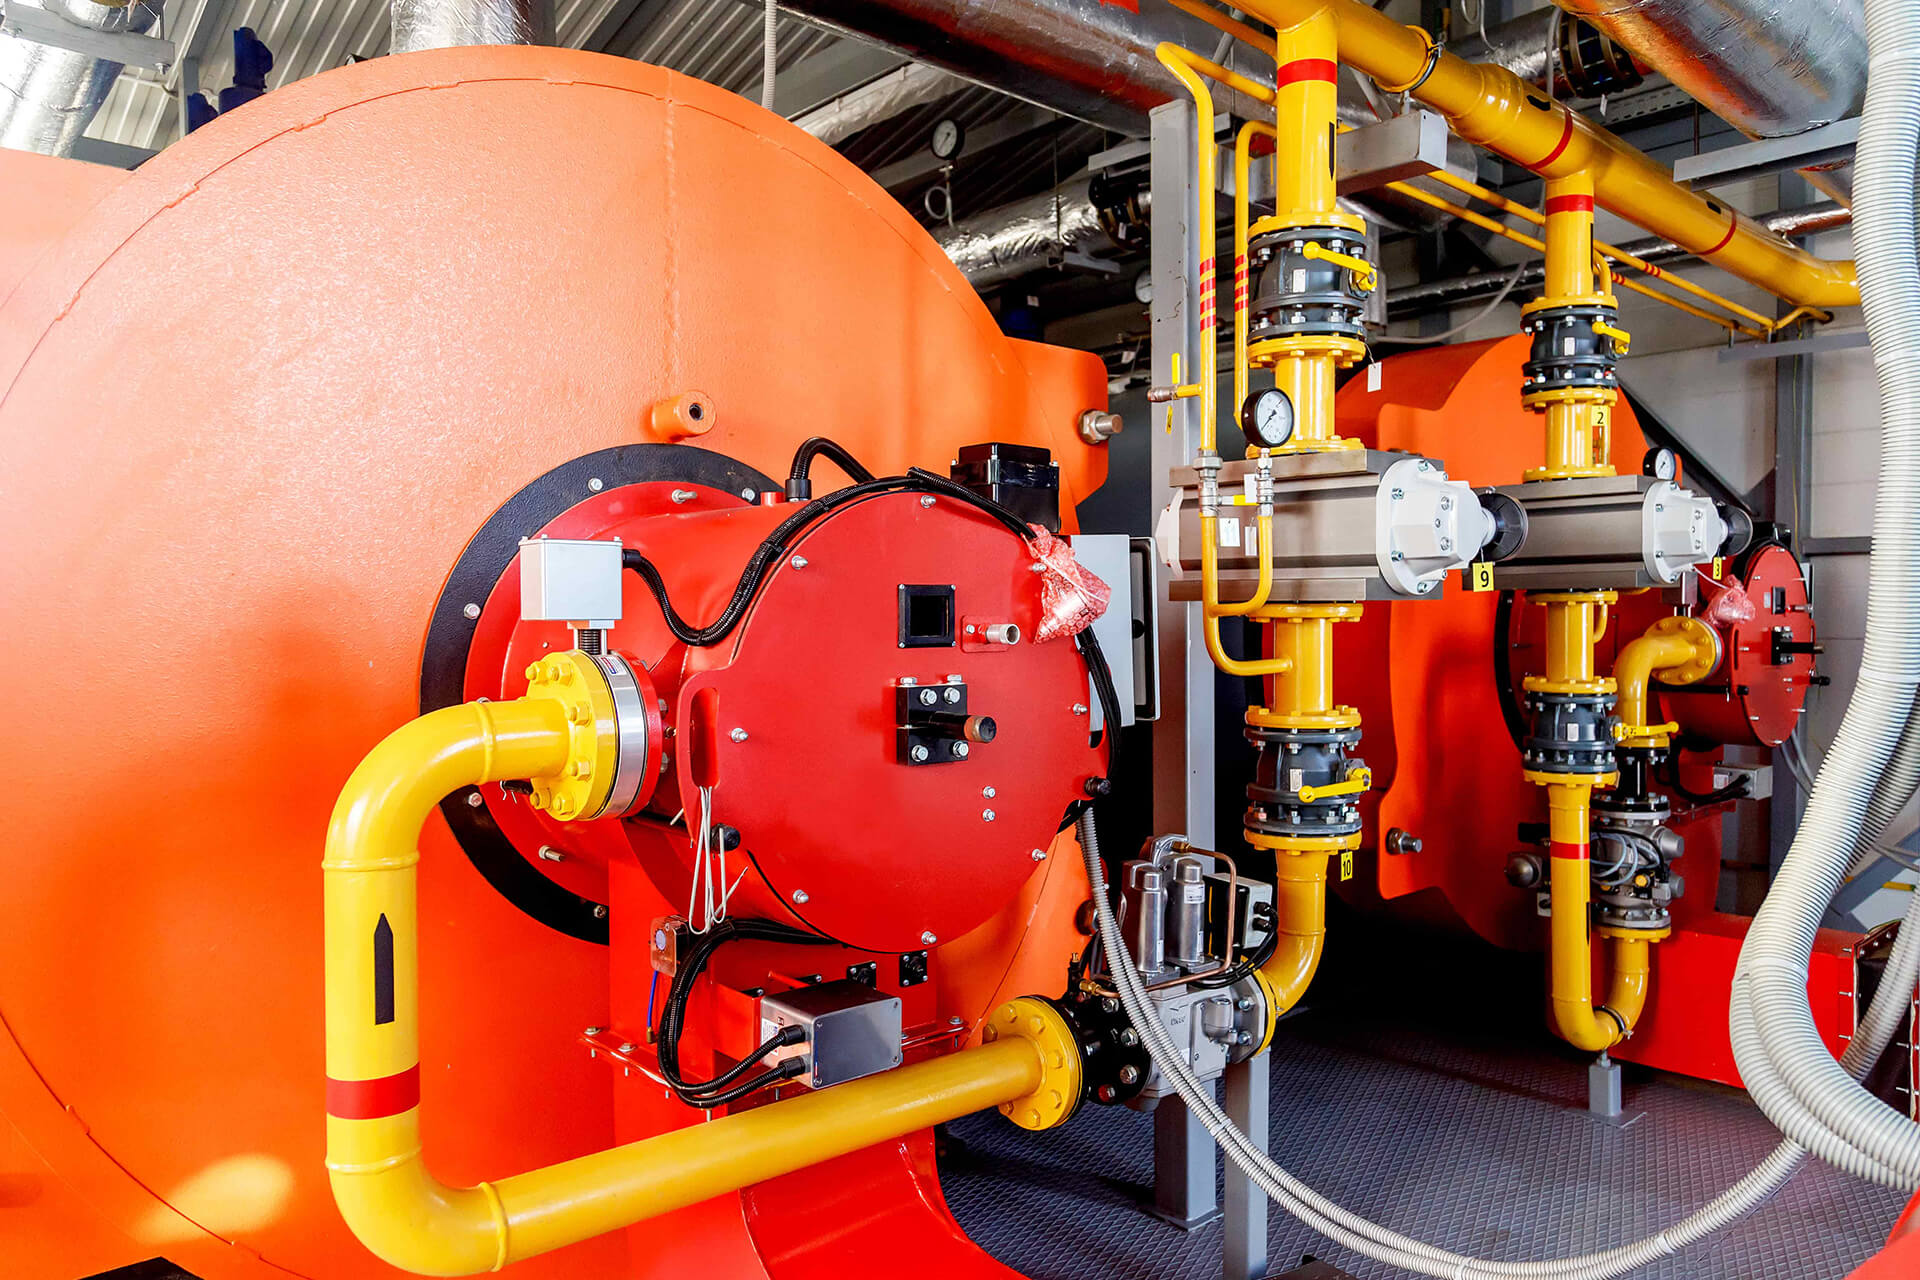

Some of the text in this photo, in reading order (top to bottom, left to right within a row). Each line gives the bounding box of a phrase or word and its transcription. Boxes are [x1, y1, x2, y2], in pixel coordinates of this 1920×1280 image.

[1597, 411, 1604, 425] 2
[1480, 570, 1489, 587] 9
[1343, 859, 1351, 877] 10
